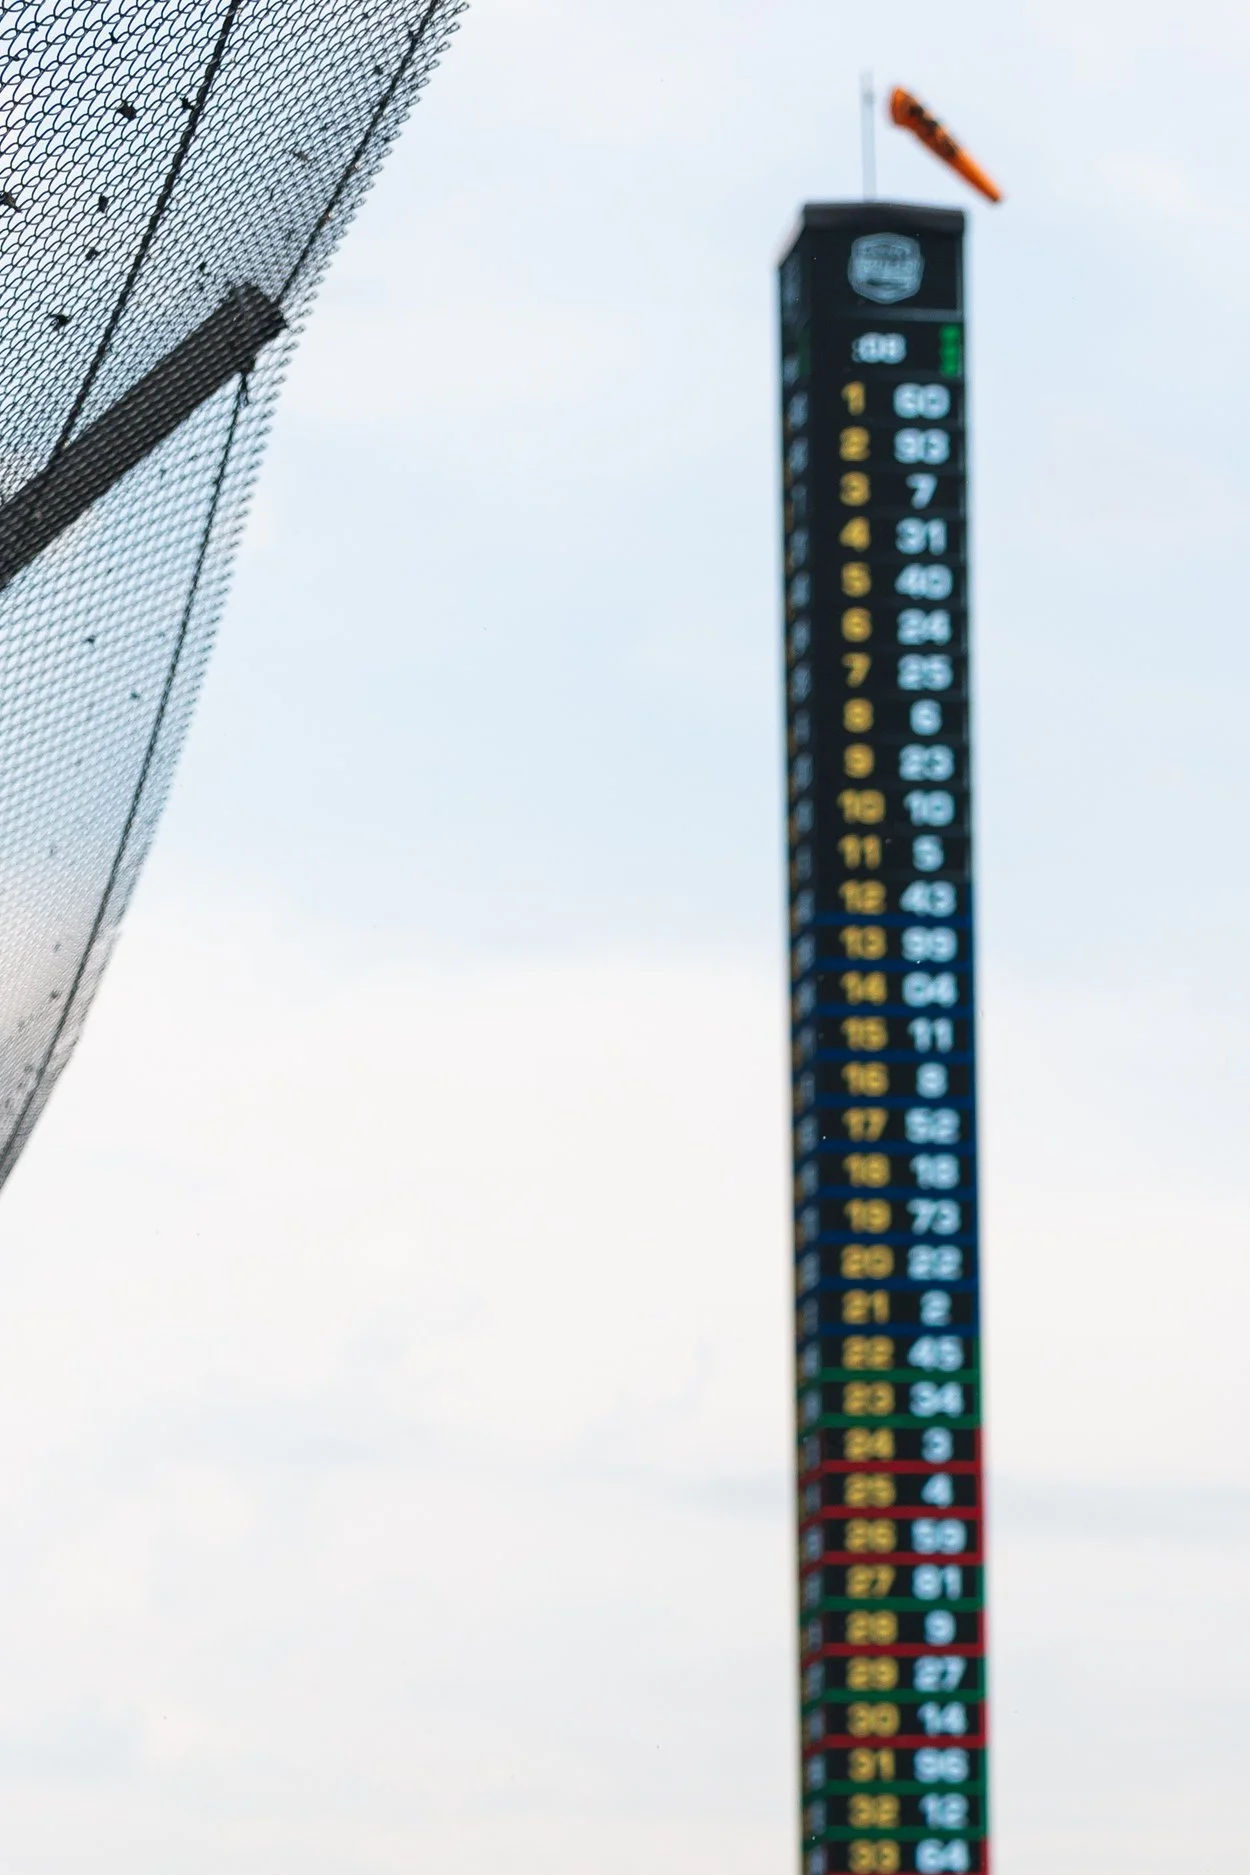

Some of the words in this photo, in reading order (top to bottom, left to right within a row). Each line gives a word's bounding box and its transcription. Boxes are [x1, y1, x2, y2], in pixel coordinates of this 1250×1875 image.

[843, 381, 866, 413] 1
[839, 425, 871, 462] 2
[841, 470, 871, 507] 3
[908, 472, 937, 507] 7
[840, 516, 871, 550] 4
[896, 517, 947, 554] 31
[841, 561, 872, 597] 5
[895, 563, 953, 600] 40
[841, 606, 872, 643] 6
[897, 608, 951, 645] 24
[845, 651, 872, 685] 7
[898, 653, 953, 691] 25
[843, 697, 874, 733] 8
[910, 699, 942, 735] 6
[843, 743, 875, 779] 9
[899, 744, 954, 781] 23
[839, 788, 886, 825] 10
[904, 790, 954, 827] 10
[839, 834, 882, 866] 11
[912, 835, 944, 871] 5
[840, 879, 886, 915] 12
[900, 880, 956, 916] 43
[841, 925, 887, 960] 13
[842, 970, 888, 1004] 14
[902, 971, 956, 1007] 04
[842, 1016, 888, 1051] 15
[909, 1017, 953, 1050] 11
[843, 1061, 889, 1096] 16
[844, 1107, 888, 1139] 17
[844, 1153, 891, 1188] 18
[845, 1198, 892, 1234] 19
[909, 1198, 960, 1235] 73
[840, 1243, 895, 1279] 20
[908, 1244, 962, 1280] 22
[842, 1289, 890, 1324] 21
[921, 1290, 951, 1326] 2
[842, 1335, 895, 1371] 22
[909, 1335, 963, 1372] 45
[843, 1381, 895, 1417] 23
[911, 1381, 963, 1417] 34
[844, 1427, 895, 1464] 24
[923, 1427, 952, 1464] 3
[844, 1471, 897, 1510] 25
[923, 1472, 953, 1507] 4
[845, 1517, 897, 1555] 26
[846, 1562, 896, 1599] 27
[846, 1610, 898, 1647] 28
[926, 1610, 956, 1646] 9
[846, 1654, 899, 1691] 29
[914, 1655, 965, 1692] 27
[849, 1702, 900, 1739] 30
[920, 1702, 967, 1736] 14
[850, 1745, 896, 1782] 31
[849, 1793, 900, 1829] 32
[922, 1793, 968, 1829] 12
[916, 1838, 970, 1875] 64
